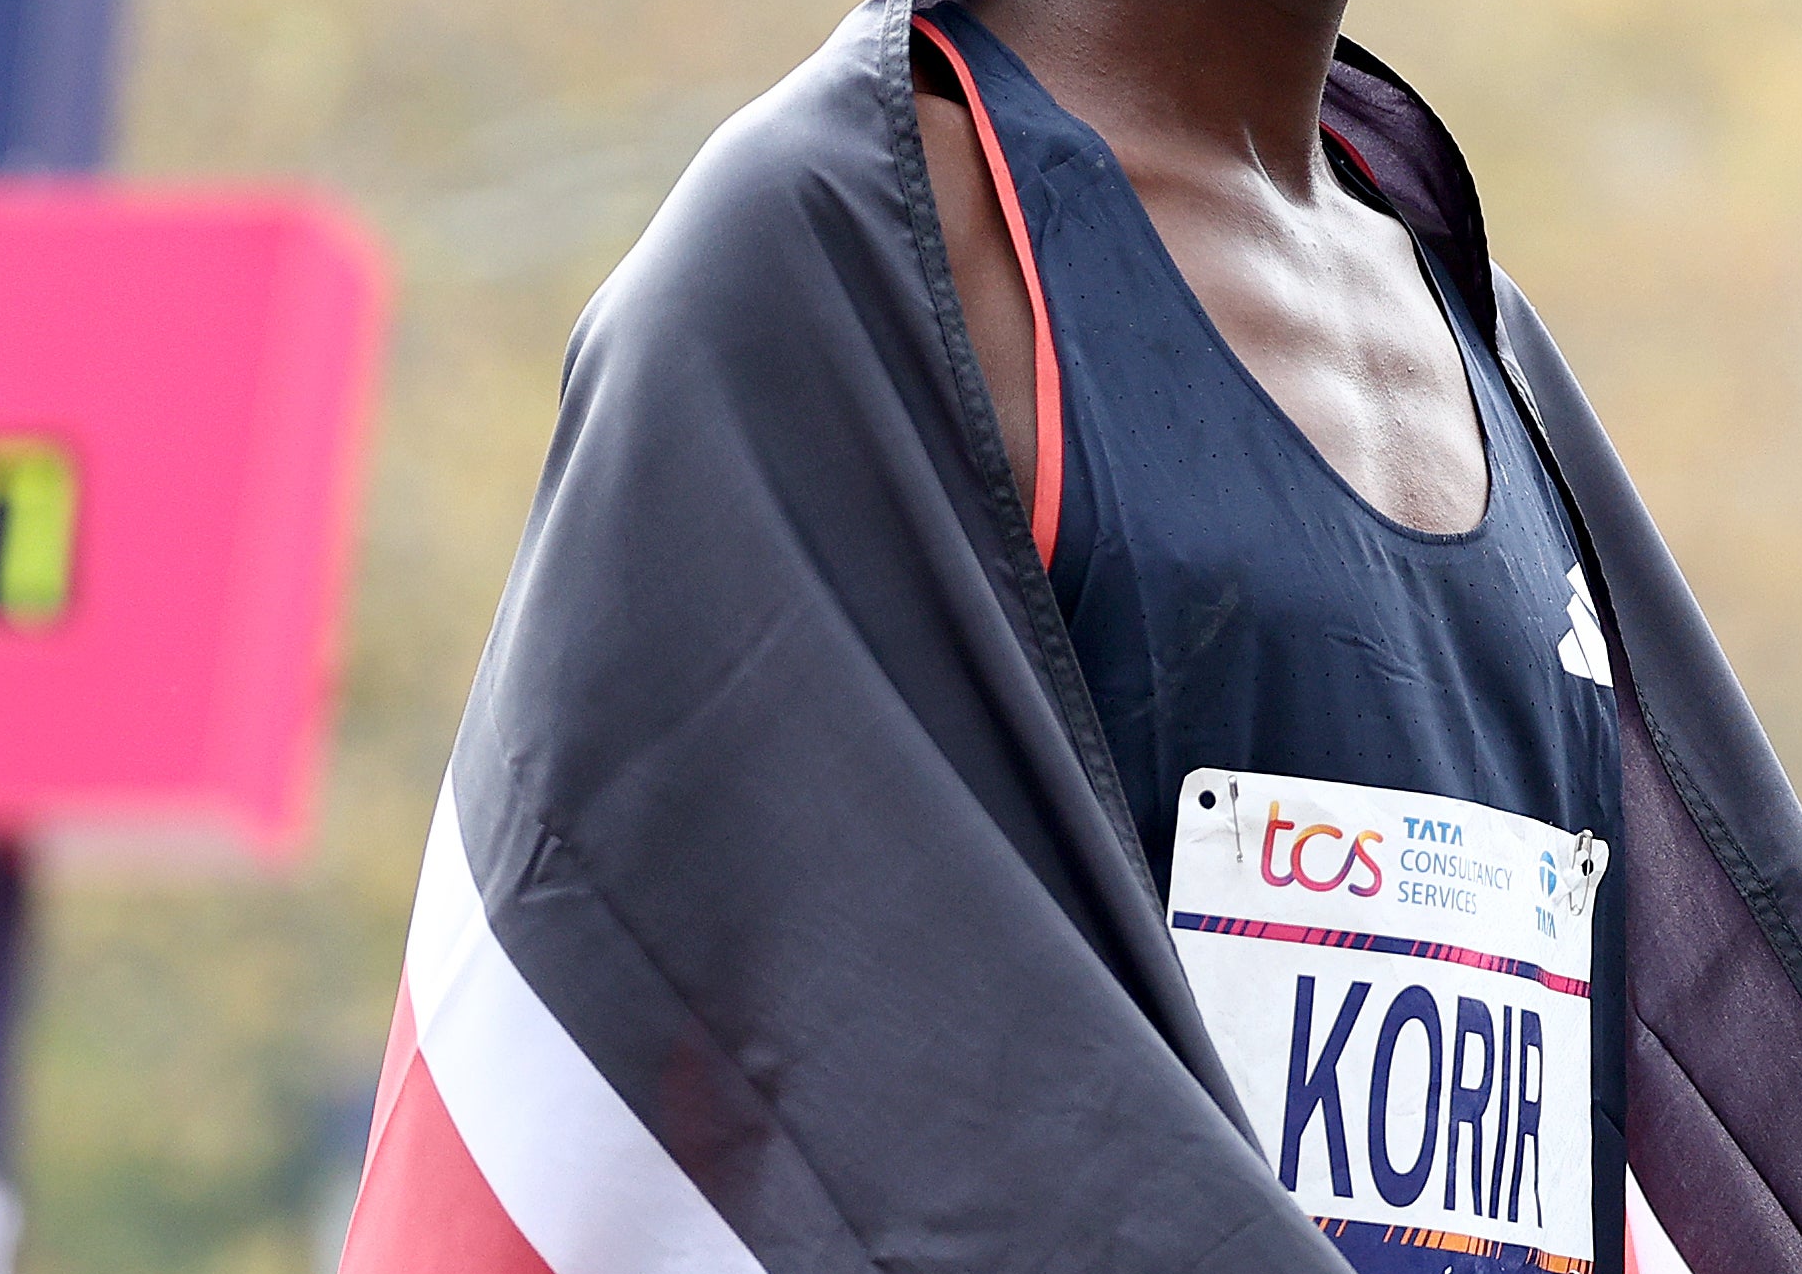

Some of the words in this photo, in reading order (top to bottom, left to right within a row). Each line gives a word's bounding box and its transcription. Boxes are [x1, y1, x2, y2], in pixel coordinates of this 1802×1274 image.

[1261, 800, 1383, 897] tcs
[1403, 816, 1463, 846] TATA
[1400, 848, 1512, 890] CONSULTANCY
[1397, 880, 1477, 915] SERVICES
[1535, 905, 1556, 939] TATA
[1278, 974, 1543, 1227] KORIR
